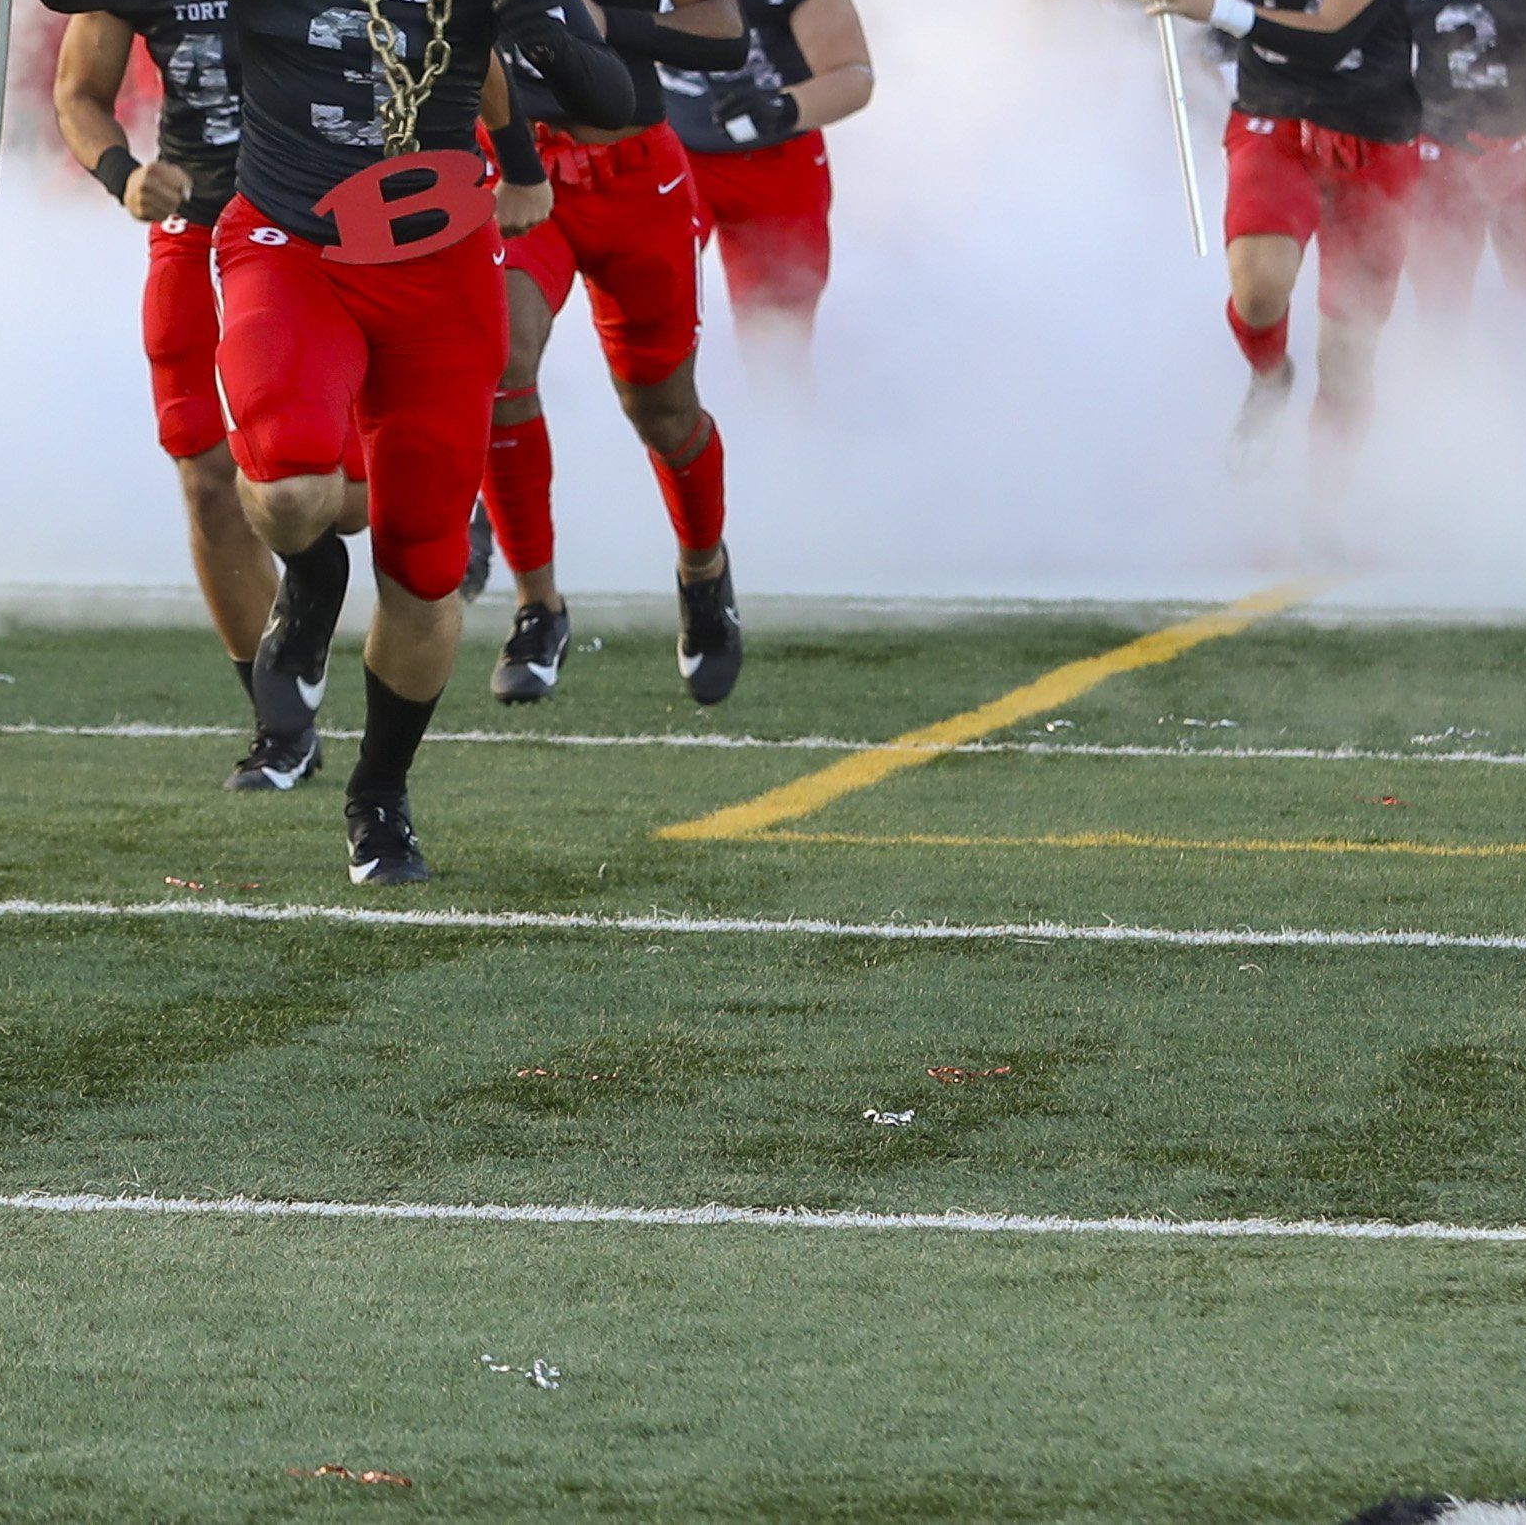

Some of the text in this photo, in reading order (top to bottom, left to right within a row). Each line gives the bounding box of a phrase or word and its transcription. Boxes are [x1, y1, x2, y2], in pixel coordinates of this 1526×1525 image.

[174, 0, 229, 22] FORT
[1435, 4, 1509, 89] 2
[308, 7, 408, 147] 3
[248, 226, 289, 245] B
[311, 149, 496, 265] B
